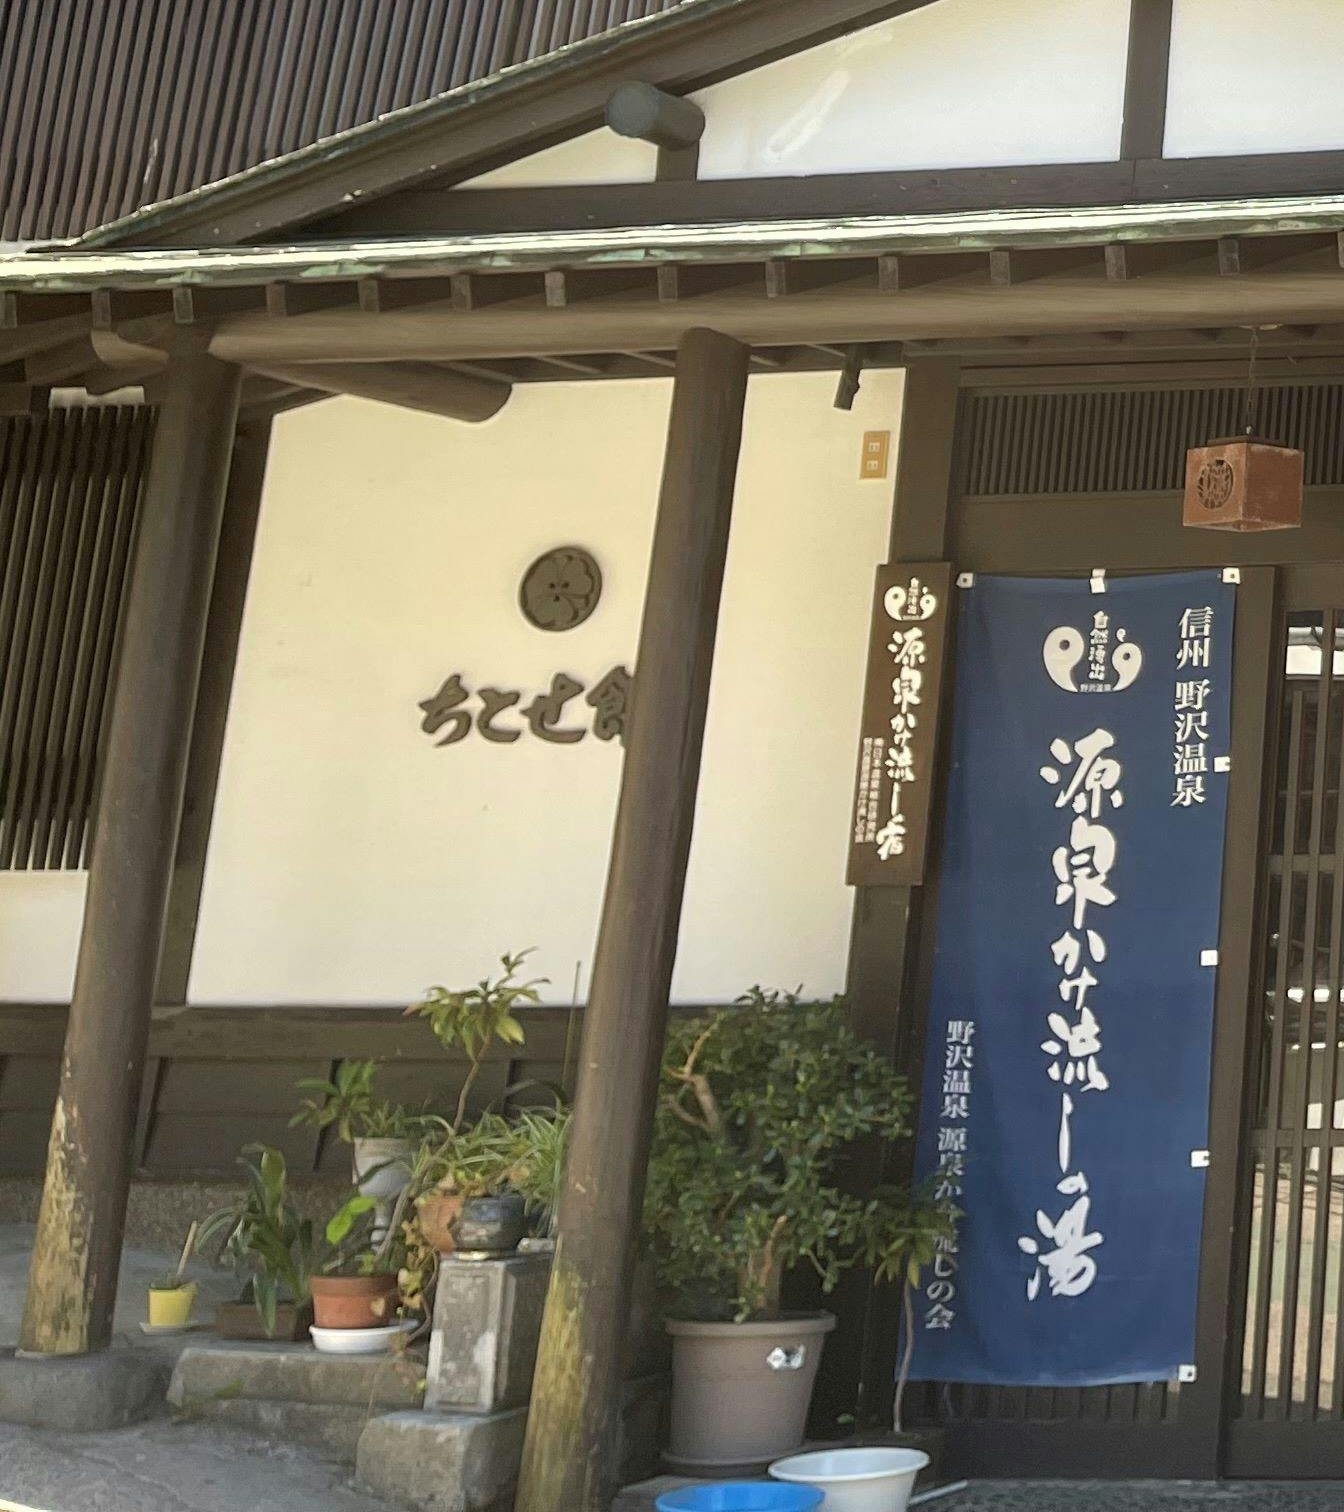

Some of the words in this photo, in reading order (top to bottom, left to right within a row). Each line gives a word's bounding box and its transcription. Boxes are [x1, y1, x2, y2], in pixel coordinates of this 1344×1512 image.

[1176, 606, 1214, 670] 信州
[1170, 678, 1211, 807] 野沢温泉
[941, 1020, 975, 1119] 野沢温泉
[1017, 727, 1124, 1301] 源泉かけ流しの湯
